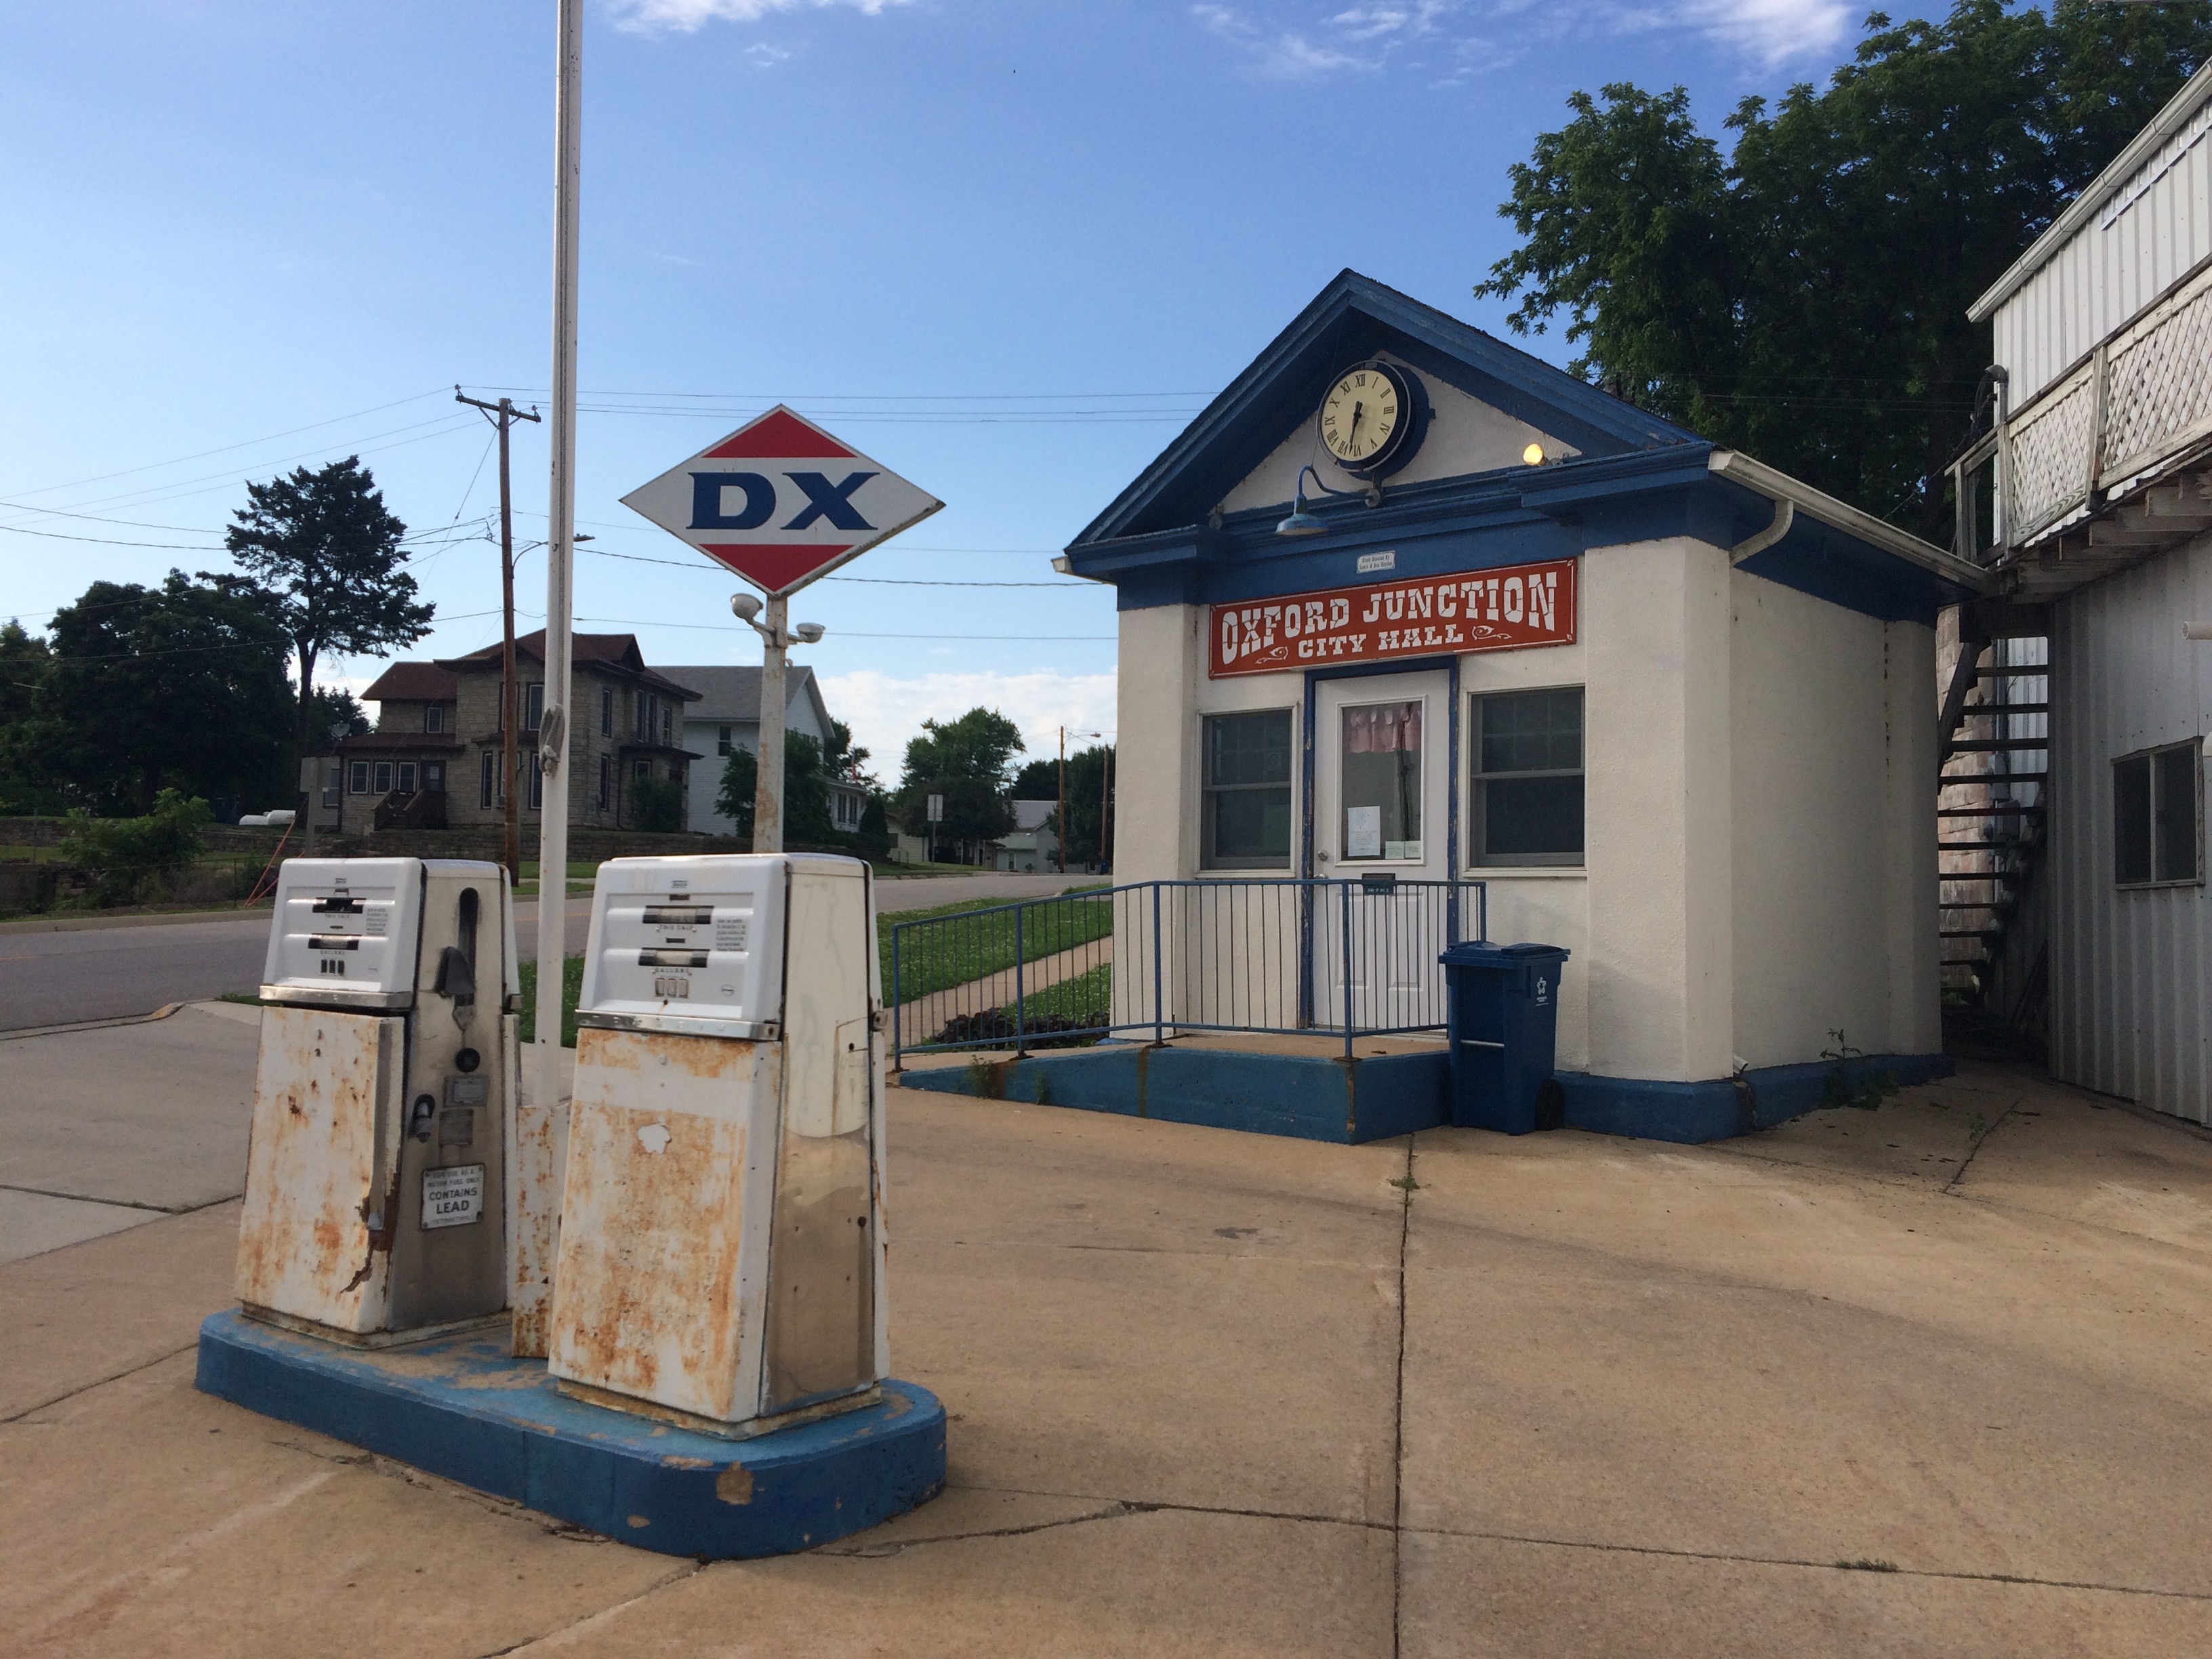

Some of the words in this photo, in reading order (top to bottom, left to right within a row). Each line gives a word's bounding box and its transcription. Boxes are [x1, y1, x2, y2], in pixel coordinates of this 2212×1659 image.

[1355, 373, 1366, 388] XII
[1340, 381, 1351, 396] XI
[1380, 388, 1391, 399] II
[1328, 397, 1340, 408] X
[1383, 405, 1395, 415] III
[1324, 415, 1336, 426] IX
[1378, 422, 1391, 435] IV
[1326, 428, 1339, 447] VIII
[1370, 438, 1378, 449] V
[1336, 440, 1349, 455] VII
[1353, 444, 1361, 457] VI
[686, 472, 880, 531] DX
[1223, 598, 1349, 665] OXFORD
[1362, 572, 1557, 632] JUNCTION
[1298, 634, 1367, 658] CITY
[1378, 624, 1464, 651] HALL
[429, 1187, 477, 1201] CONTAINS
[436, 1200, 470, 1214] LEAD
